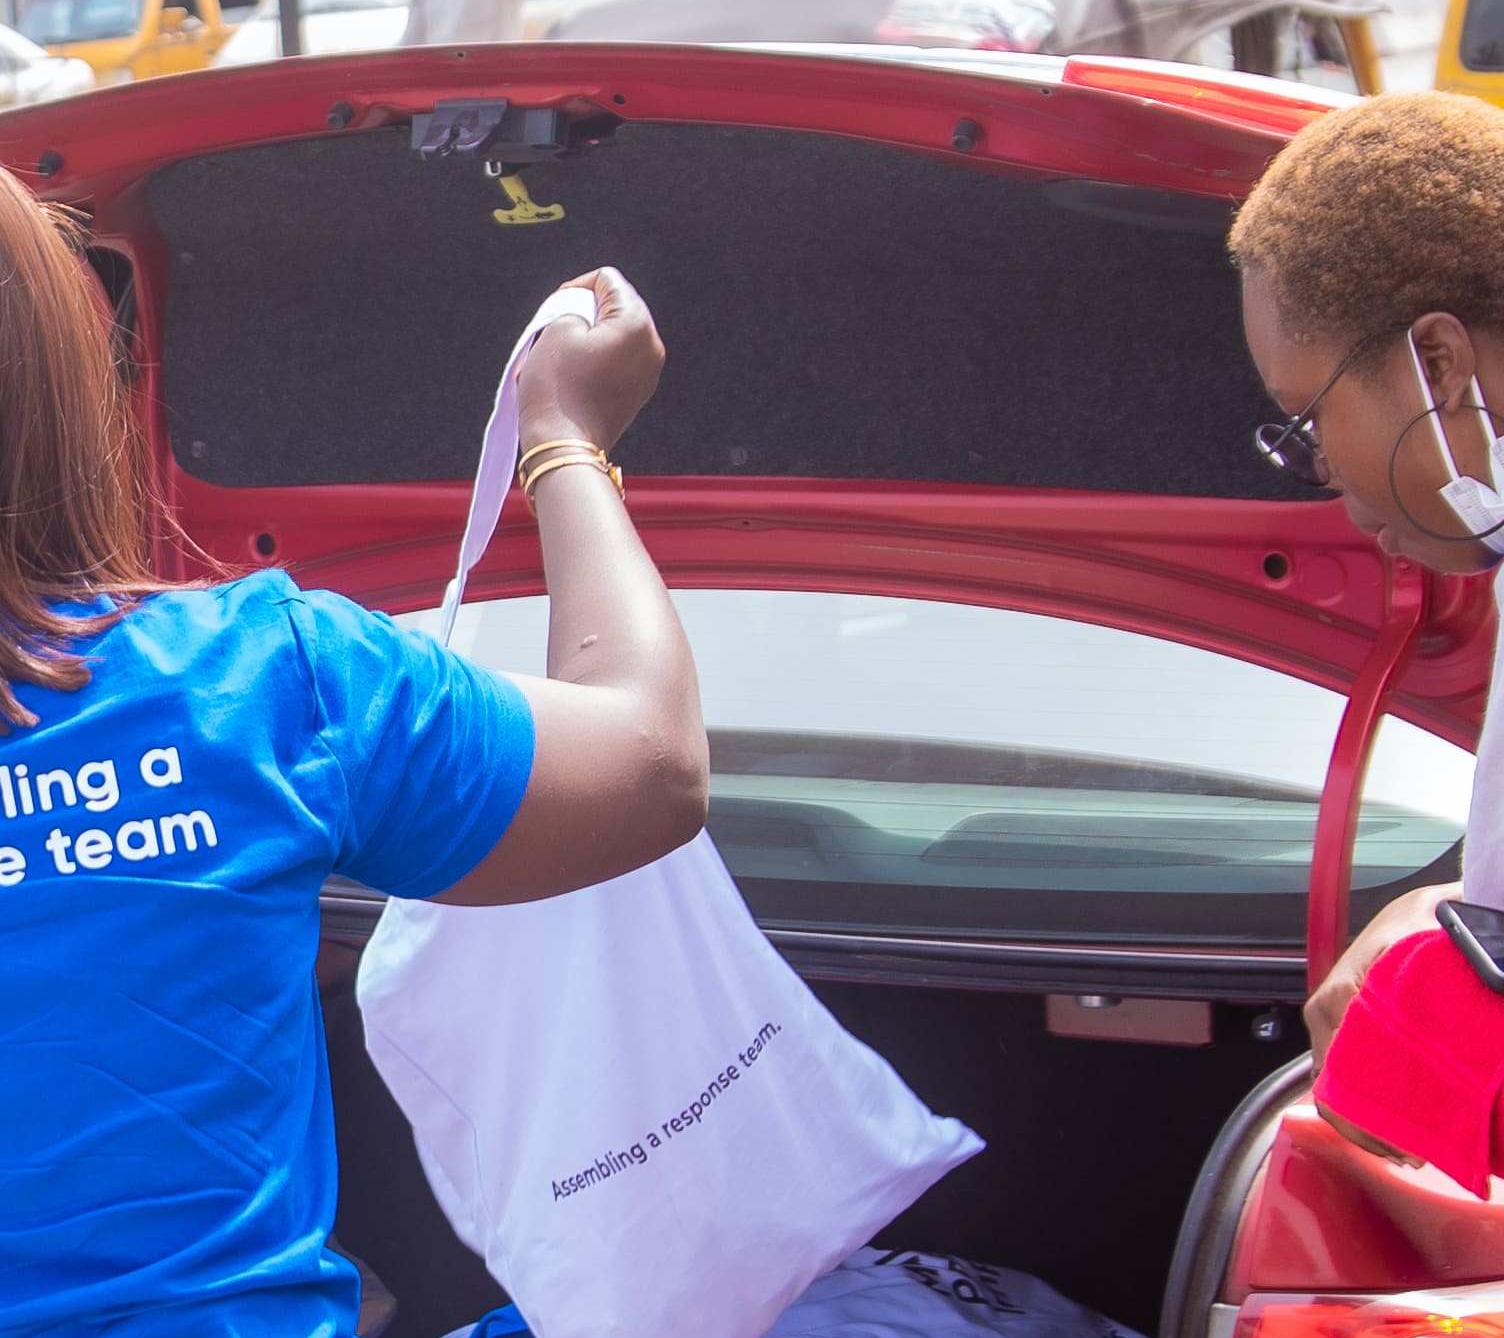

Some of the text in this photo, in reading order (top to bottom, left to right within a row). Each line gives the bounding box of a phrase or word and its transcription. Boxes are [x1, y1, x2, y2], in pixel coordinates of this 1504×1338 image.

[140, 746, 183, 789] a
[45, 808, 218, 875] team
[551, 1021, 782, 1202] Assembling a response team.
